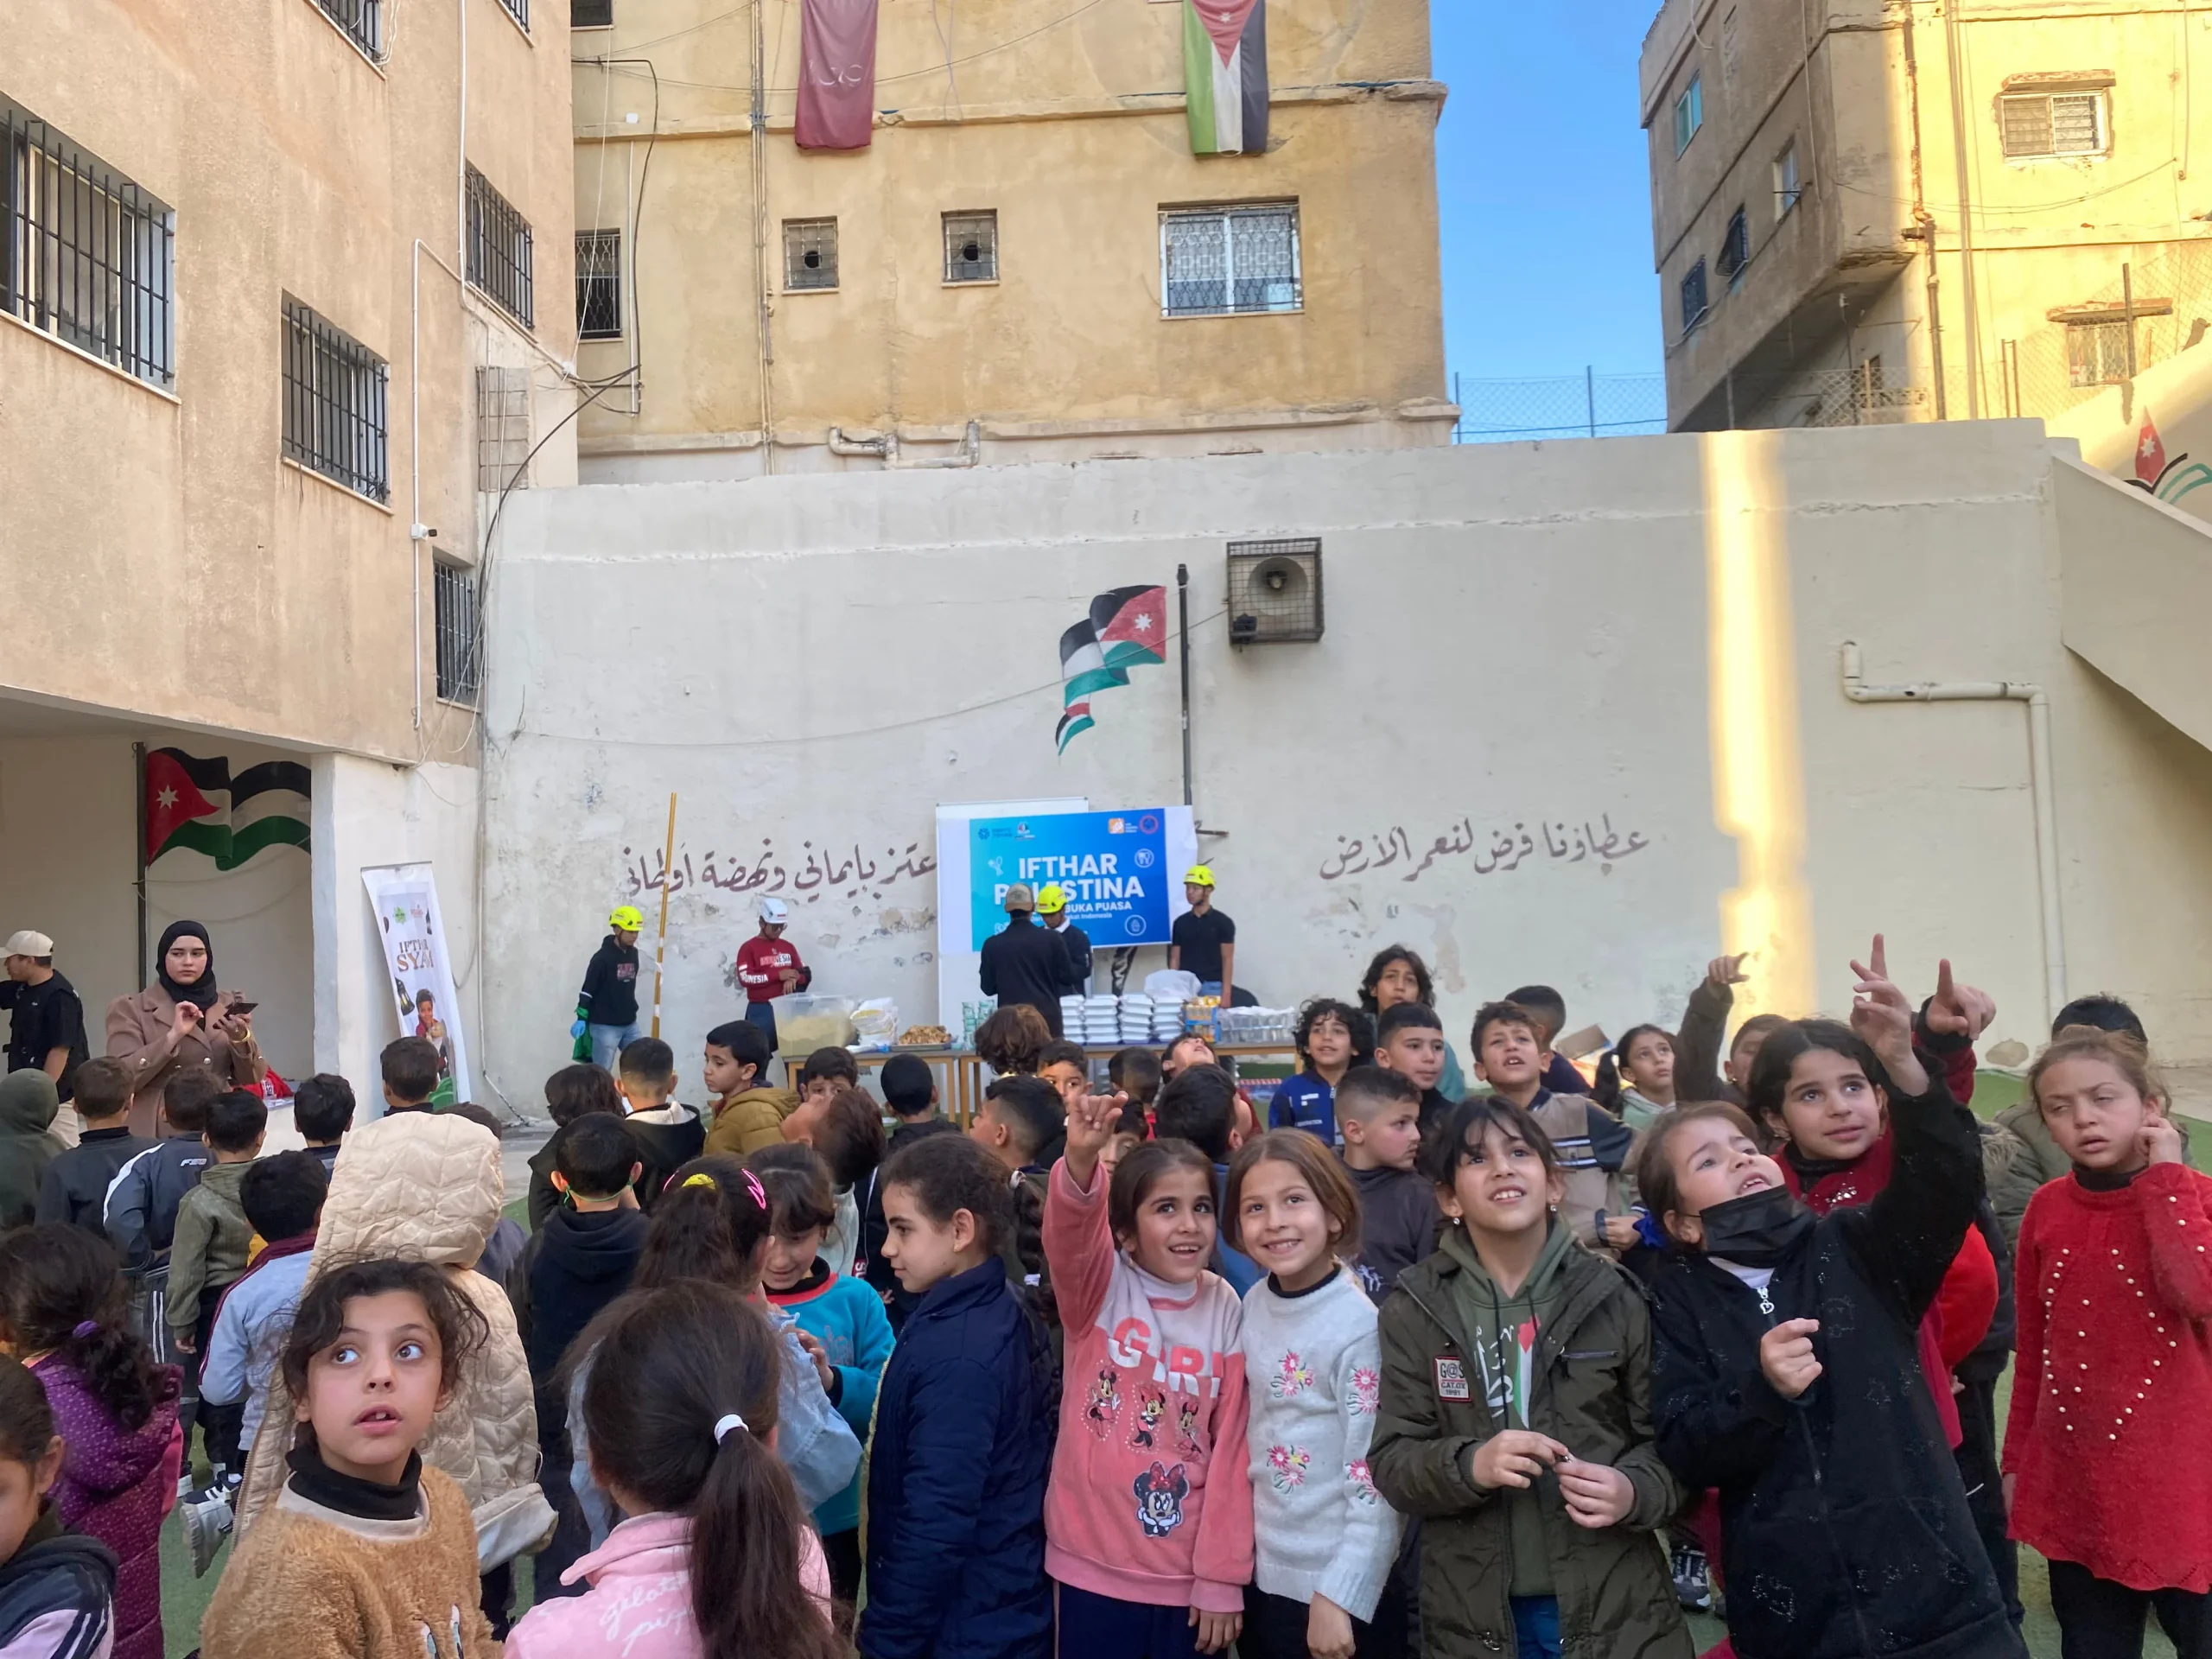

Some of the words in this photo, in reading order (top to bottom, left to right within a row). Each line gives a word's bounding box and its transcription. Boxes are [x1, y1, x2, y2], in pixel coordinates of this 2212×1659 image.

[877, 842, 938, 885] عتز
[1019, 853, 1117, 880] IFTHAR
[1402, 817, 1473, 881] لنعمر
[1474, 823, 1534, 874] فرض
[994, 875, 1145, 906] PLSTINA
[1095, 900, 1133, 912] PUASA
